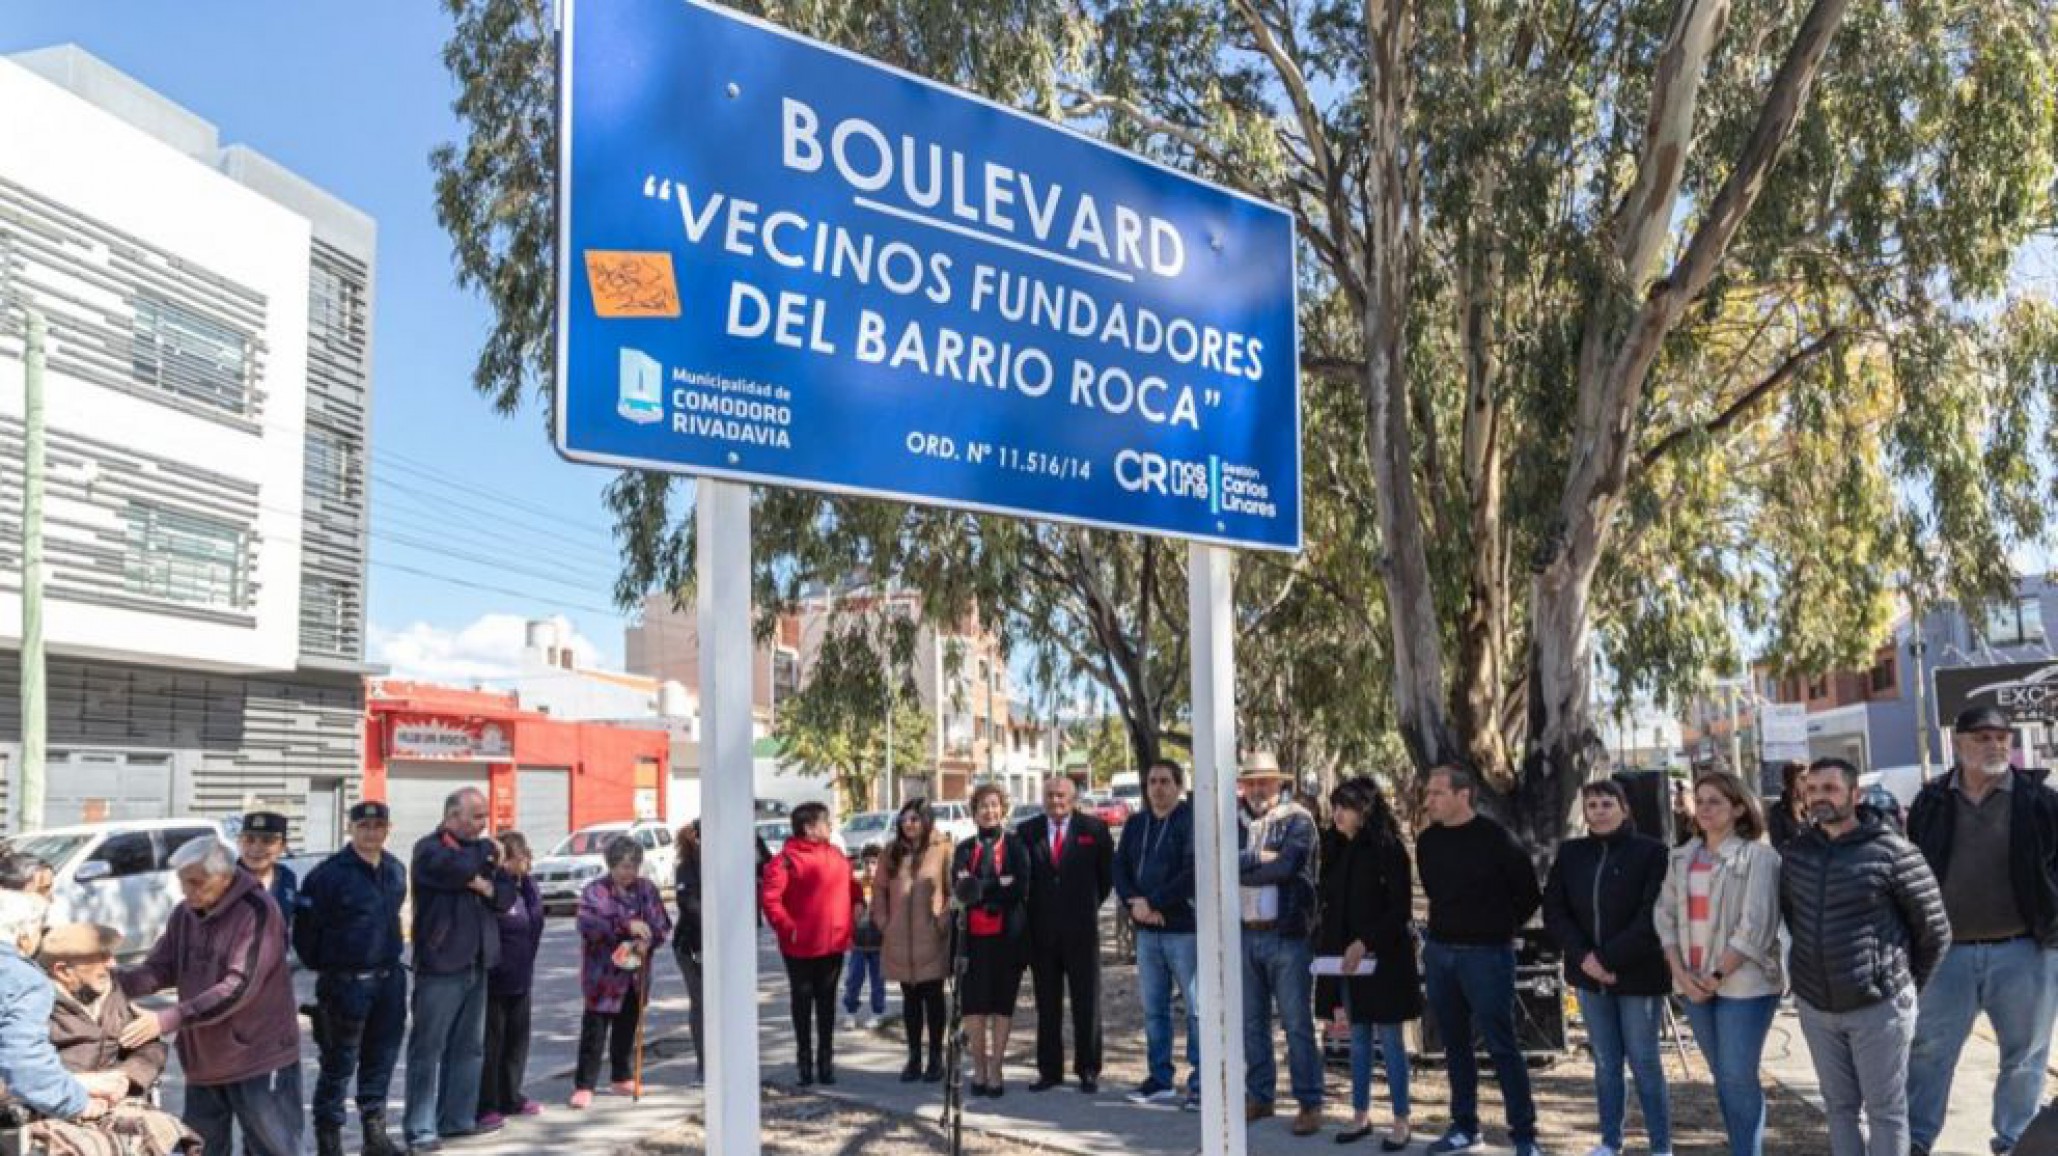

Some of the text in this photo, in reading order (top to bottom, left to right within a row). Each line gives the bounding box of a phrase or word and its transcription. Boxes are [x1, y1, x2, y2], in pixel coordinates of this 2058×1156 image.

[781, 96, 1186, 279] BOULEVARD
[970, 262, 1264, 381] FUNDADORES
[726, 281, 835, 356] DEL
[855, 308, 1054, 398] BARRIO
[1069, 358, 1221, 430] ROCA”
[672, 366, 791, 400] Municipalidad de
[672, 387, 792, 426] COMODORO
[672, 411, 792, 449] RIVADAVIA
[906, 430, 960, 461] ORD.
[999, 446, 1092, 481] 11.516/14
[1115, 450, 1169, 496] CR
[1221, 475, 1269, 499] Carlos
[1221, 493, 1277, 518] Linares
